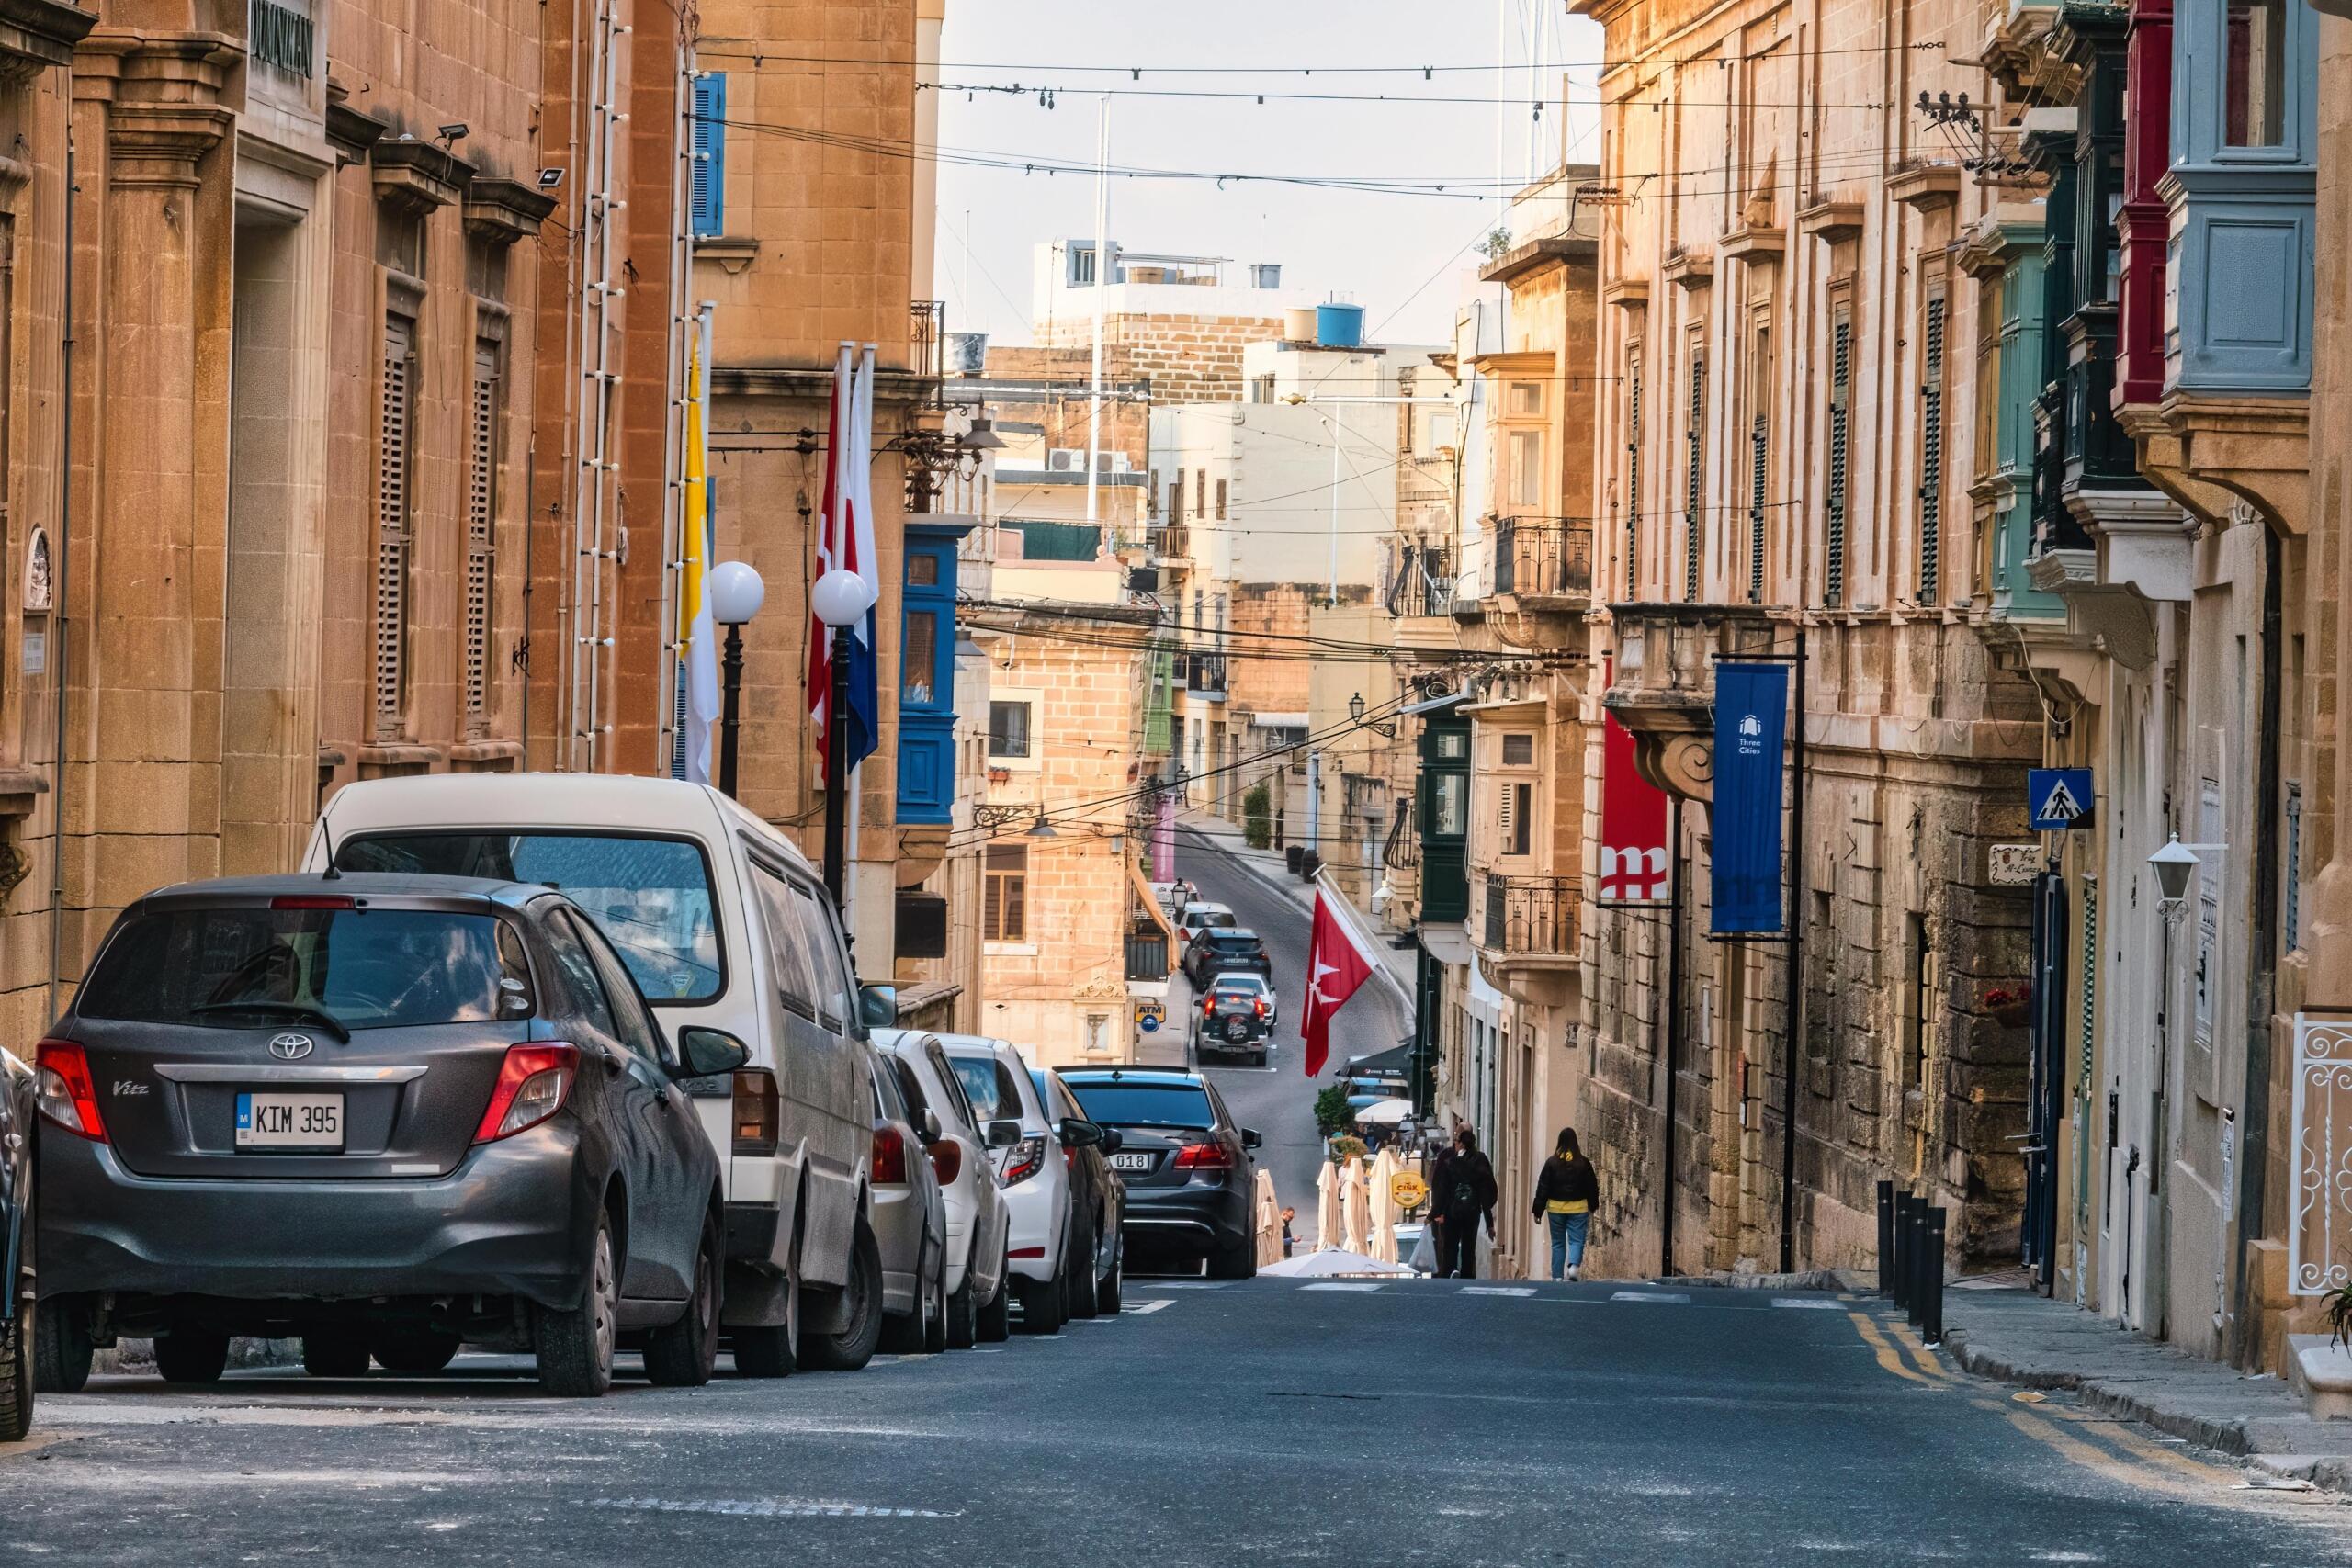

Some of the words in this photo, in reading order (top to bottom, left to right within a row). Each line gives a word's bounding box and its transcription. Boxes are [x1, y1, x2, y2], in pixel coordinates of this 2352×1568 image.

[1138, 1006, 1162, 1014] ATM
[112, 1080, 149, 1096] Vitz
[239, 1114, 249, 1123] M
[256, 1105, 293, 1133] KIM
[300, 1106, 337, 1134] 395
[1116, 1155, 1145, 1168] 018
